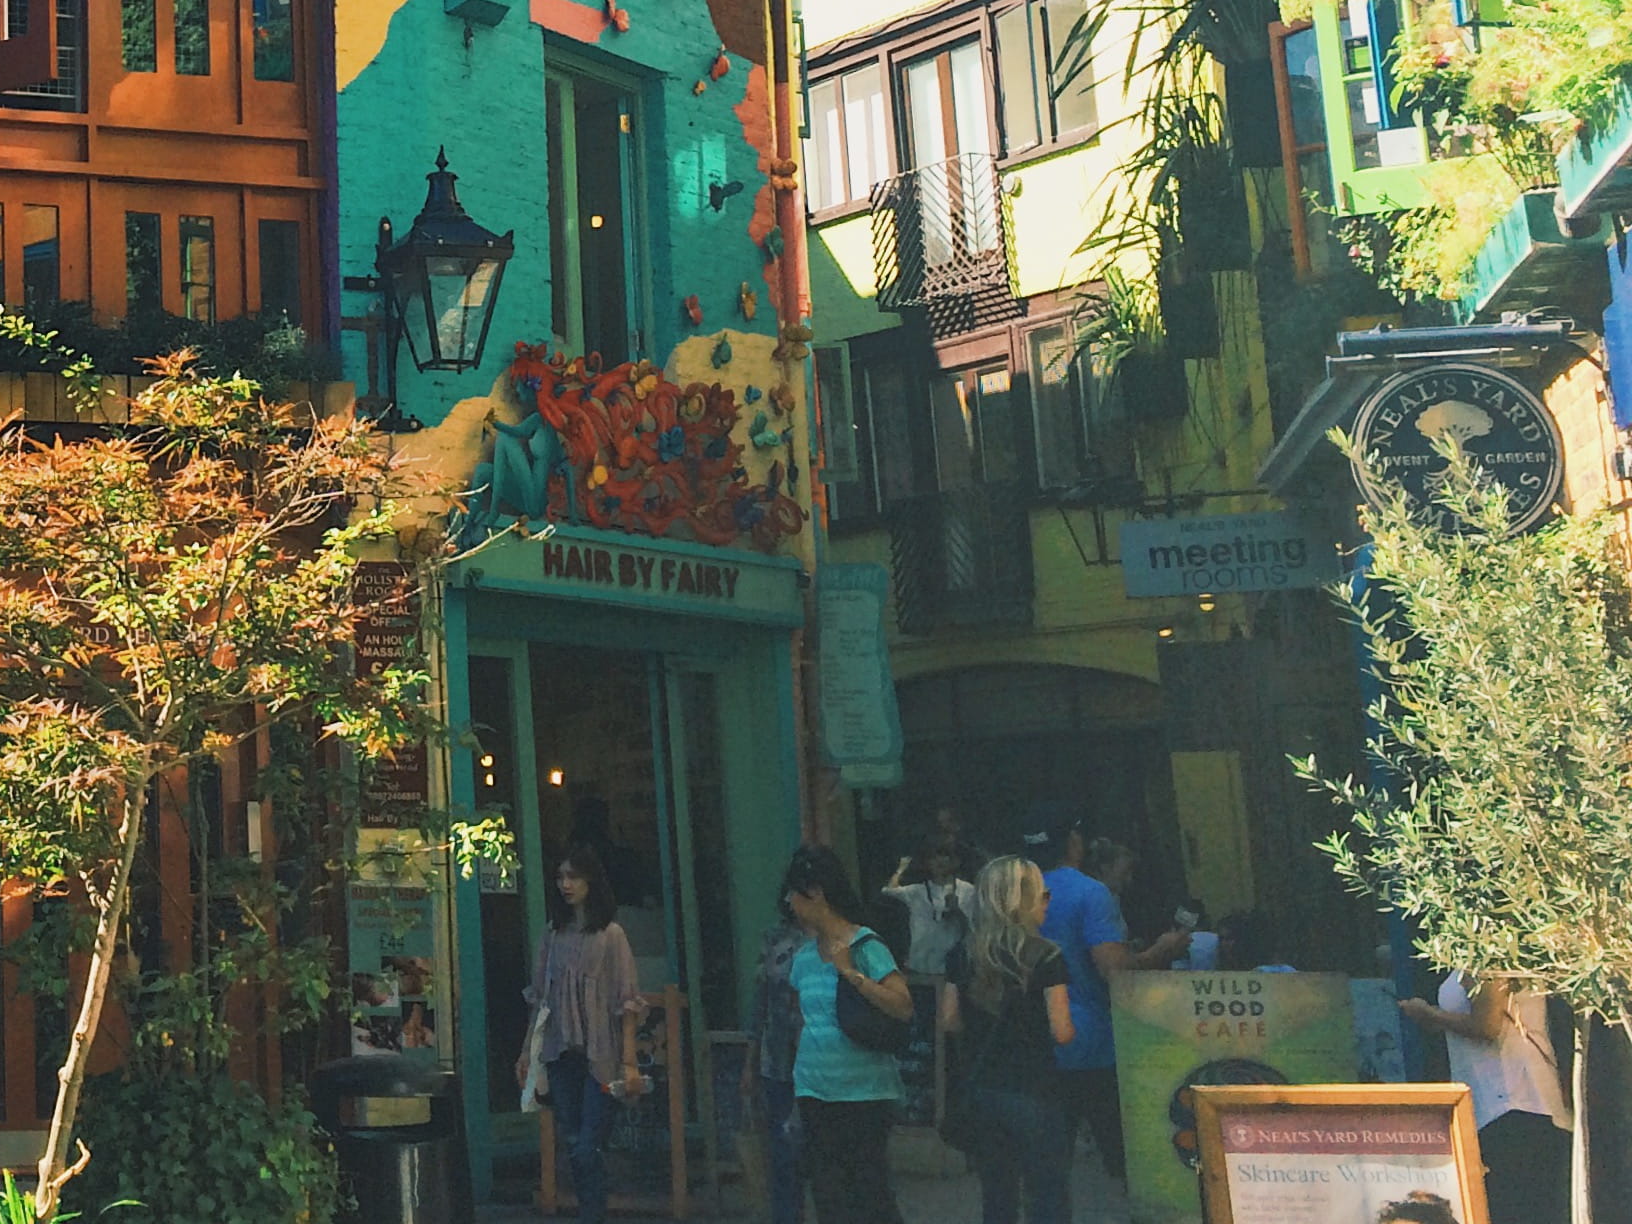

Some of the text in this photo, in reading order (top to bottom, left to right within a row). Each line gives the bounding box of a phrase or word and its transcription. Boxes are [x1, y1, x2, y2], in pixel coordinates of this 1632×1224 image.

[1372, 377, 1542, 448] NEAL'S YARD
[1372, 452, 1547, 467] OVENT GARDEN
[1149, 533, 1308, 569] meeting
[543, 542, 740, 599] HAIR BY FAIRY
[1182, 564, 1289, 590] rooms
[365, 635, 380, 644] AN
[1192, 979, 1263, 996] WILD
[1193, 1000, 1265, 1017] FOOD
[1258, 1129, 1447, 1145] NEAL'S YARD REMEDIES
[1237, 1163, 1449, 1187] Skincare Workshop
